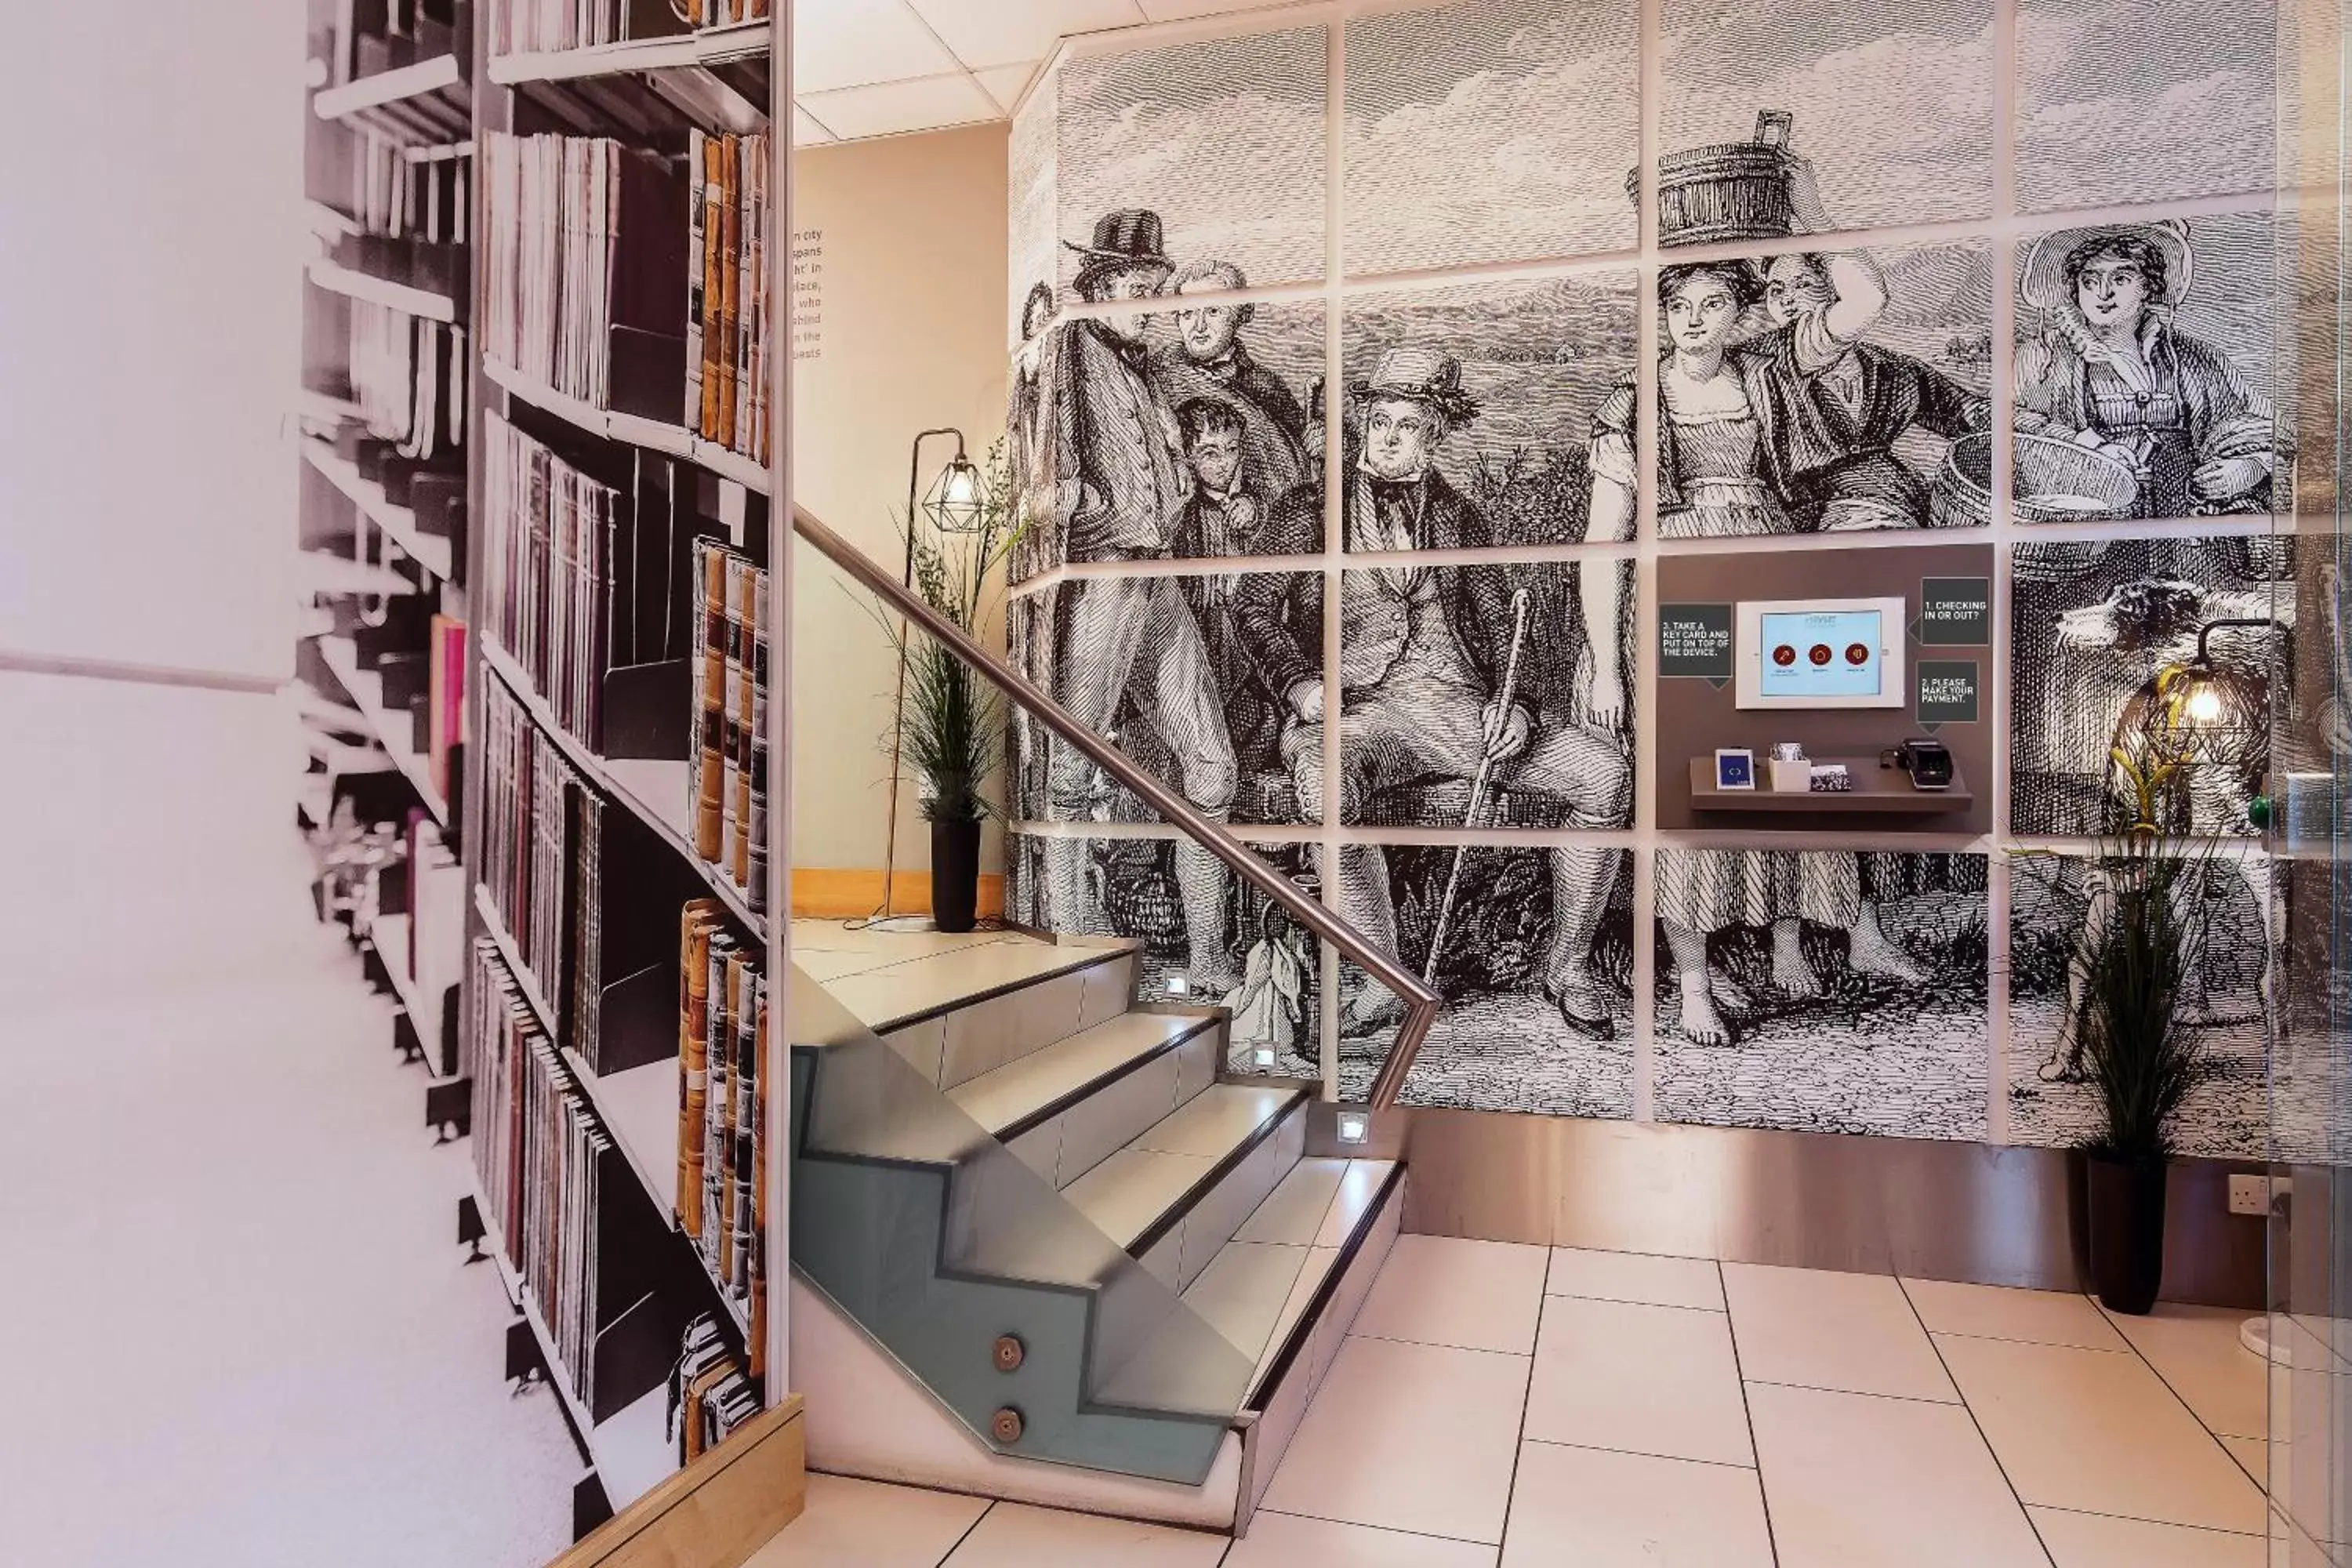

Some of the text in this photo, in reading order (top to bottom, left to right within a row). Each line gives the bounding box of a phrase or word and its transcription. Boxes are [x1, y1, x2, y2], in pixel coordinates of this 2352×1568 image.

[804, 230, 822, 242] city
[811, 263, 822, 274] in
[799, 297, 821, 308] who
[1936, 601, 1987, 610] CHECKING
[1925, 611, 1980, 620] IN OR OUT?
[1673, 622, 1697, 630] TAKE
[1663, 630, 1729, 639] KEY CARD AND
[1663, 639, 1730, 648] PUT ON TOP OF
[1931, 678, 1966, 687] PLEASE
[1922, 686, 1973, 695] MAKE YOUR
[1922, 695, 1965, 703] PAYMENT.
